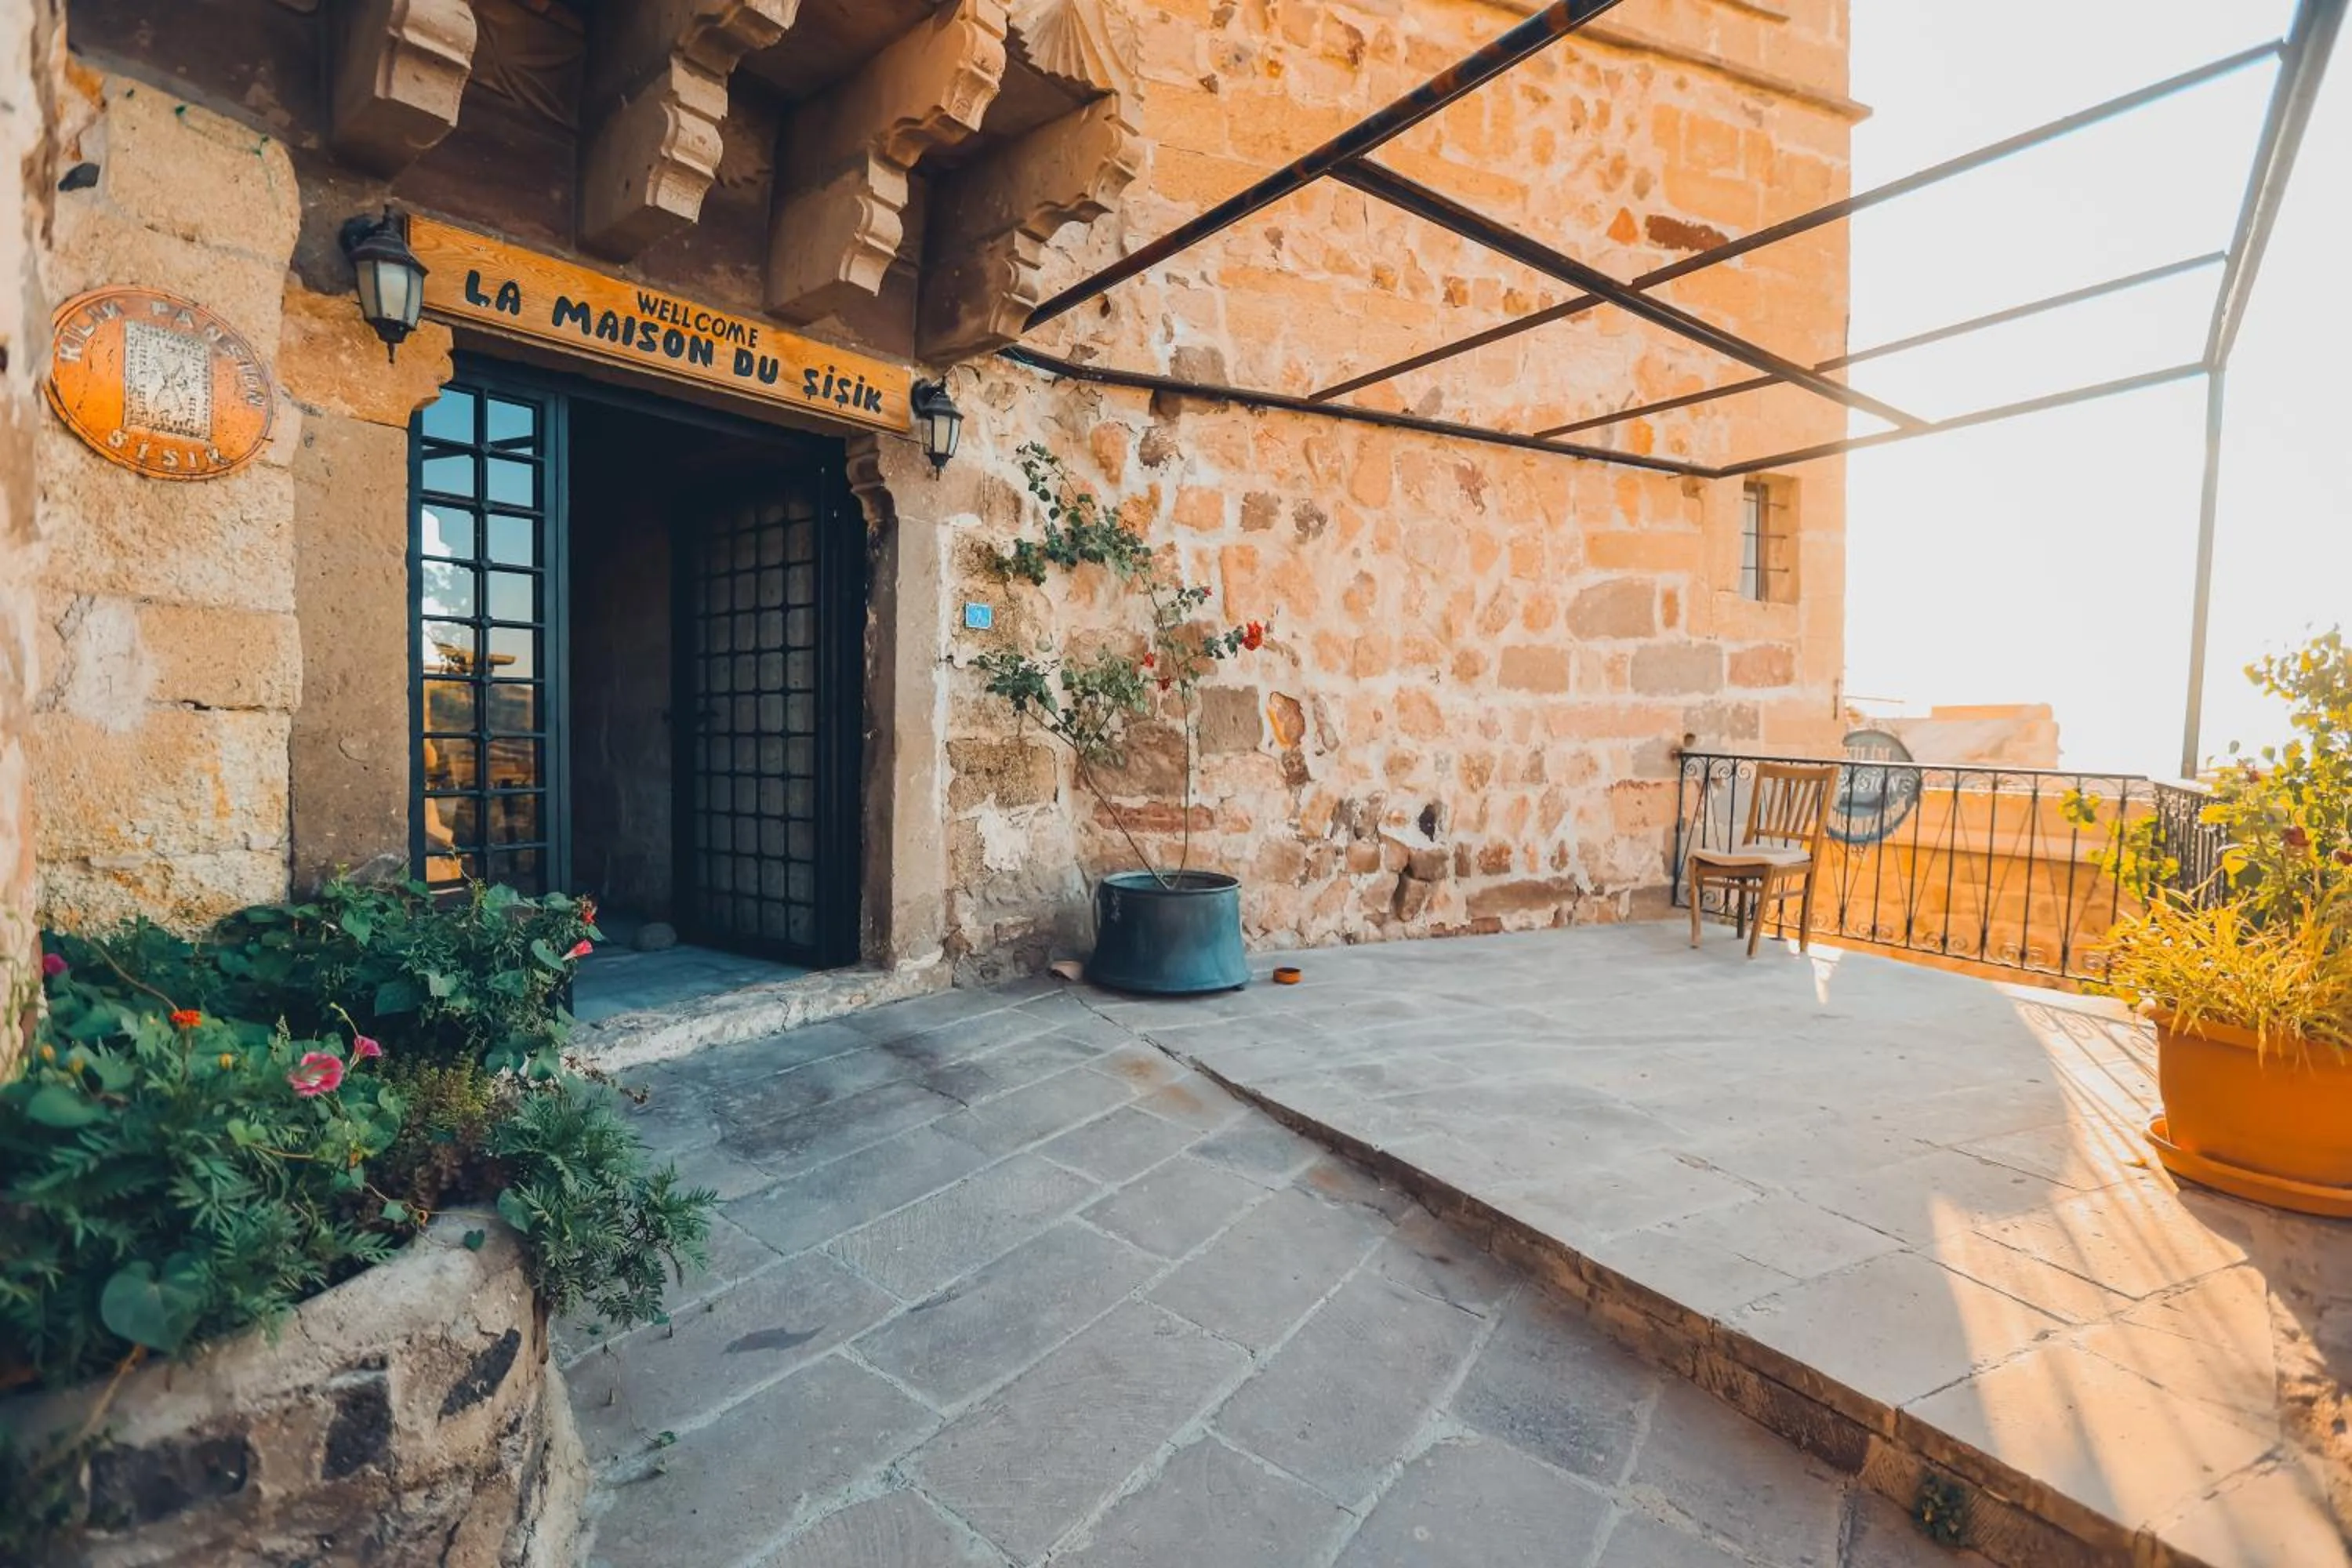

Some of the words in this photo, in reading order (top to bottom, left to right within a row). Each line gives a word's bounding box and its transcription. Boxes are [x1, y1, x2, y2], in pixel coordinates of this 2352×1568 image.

[465, 269, 521, 315] LA
[551, 295, 714, 368] MAISON
[733, 347, 779, 385] DU
[802, 365, 883, 415] ŞİŞİK
[637, 291, 758, 349] WELLCOME
